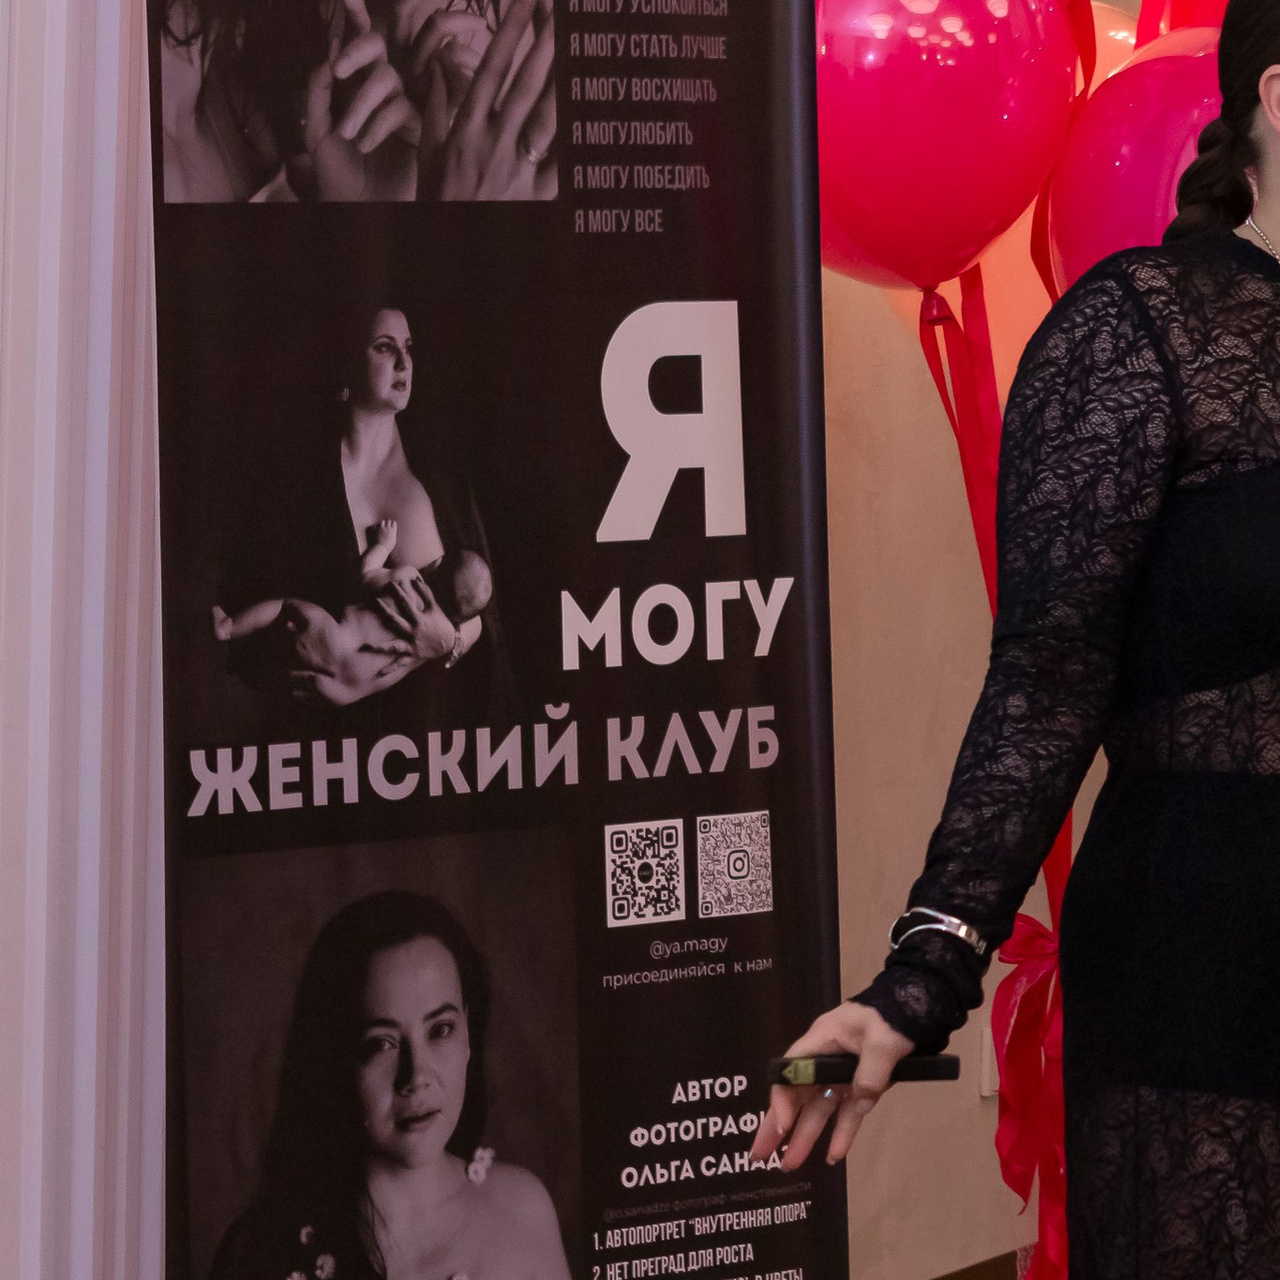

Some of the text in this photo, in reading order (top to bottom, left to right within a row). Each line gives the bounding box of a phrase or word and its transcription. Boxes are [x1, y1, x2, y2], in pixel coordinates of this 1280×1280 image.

[571, 34, 726, 58] Я МОГУ СТАТЬ ЛУЧШЕ
[572, 78, 716, 103] Я МОГУ ВОСХИЩАТЬ
[573, 123, 693, 145] Я МОГУ ЛЮБИТЬ
[574, 166, 709, 190] Я МОГУ ПОБЕДИТЬ
[576, 210, 663, 233] Я МОГУ ВСЕ
[596, 300, 746, 543] Я
[561, 577, 794, 670] МОГУ
[188, 703, 780, 817] ЖЕНСКИЙ КЛУБ
[650, 936, 728, 959] @ya.magy
[603, 958, 772, 990] присоединяйся к нам
[672, 1075, 747, 1103] АВТОР
[621, 1160, 694, 1188] ОЛЬГА
[593, 1232, 603, 1250] 1.
[606, 1220, 686, 1248] АВТОПОРТРЕТ
[632, 1254, 685, 1278] ПРЕГРАД
[688, 1251, 713, 1271] ДЛЯ
[716, 1243, 754, 1266] РОСТА
